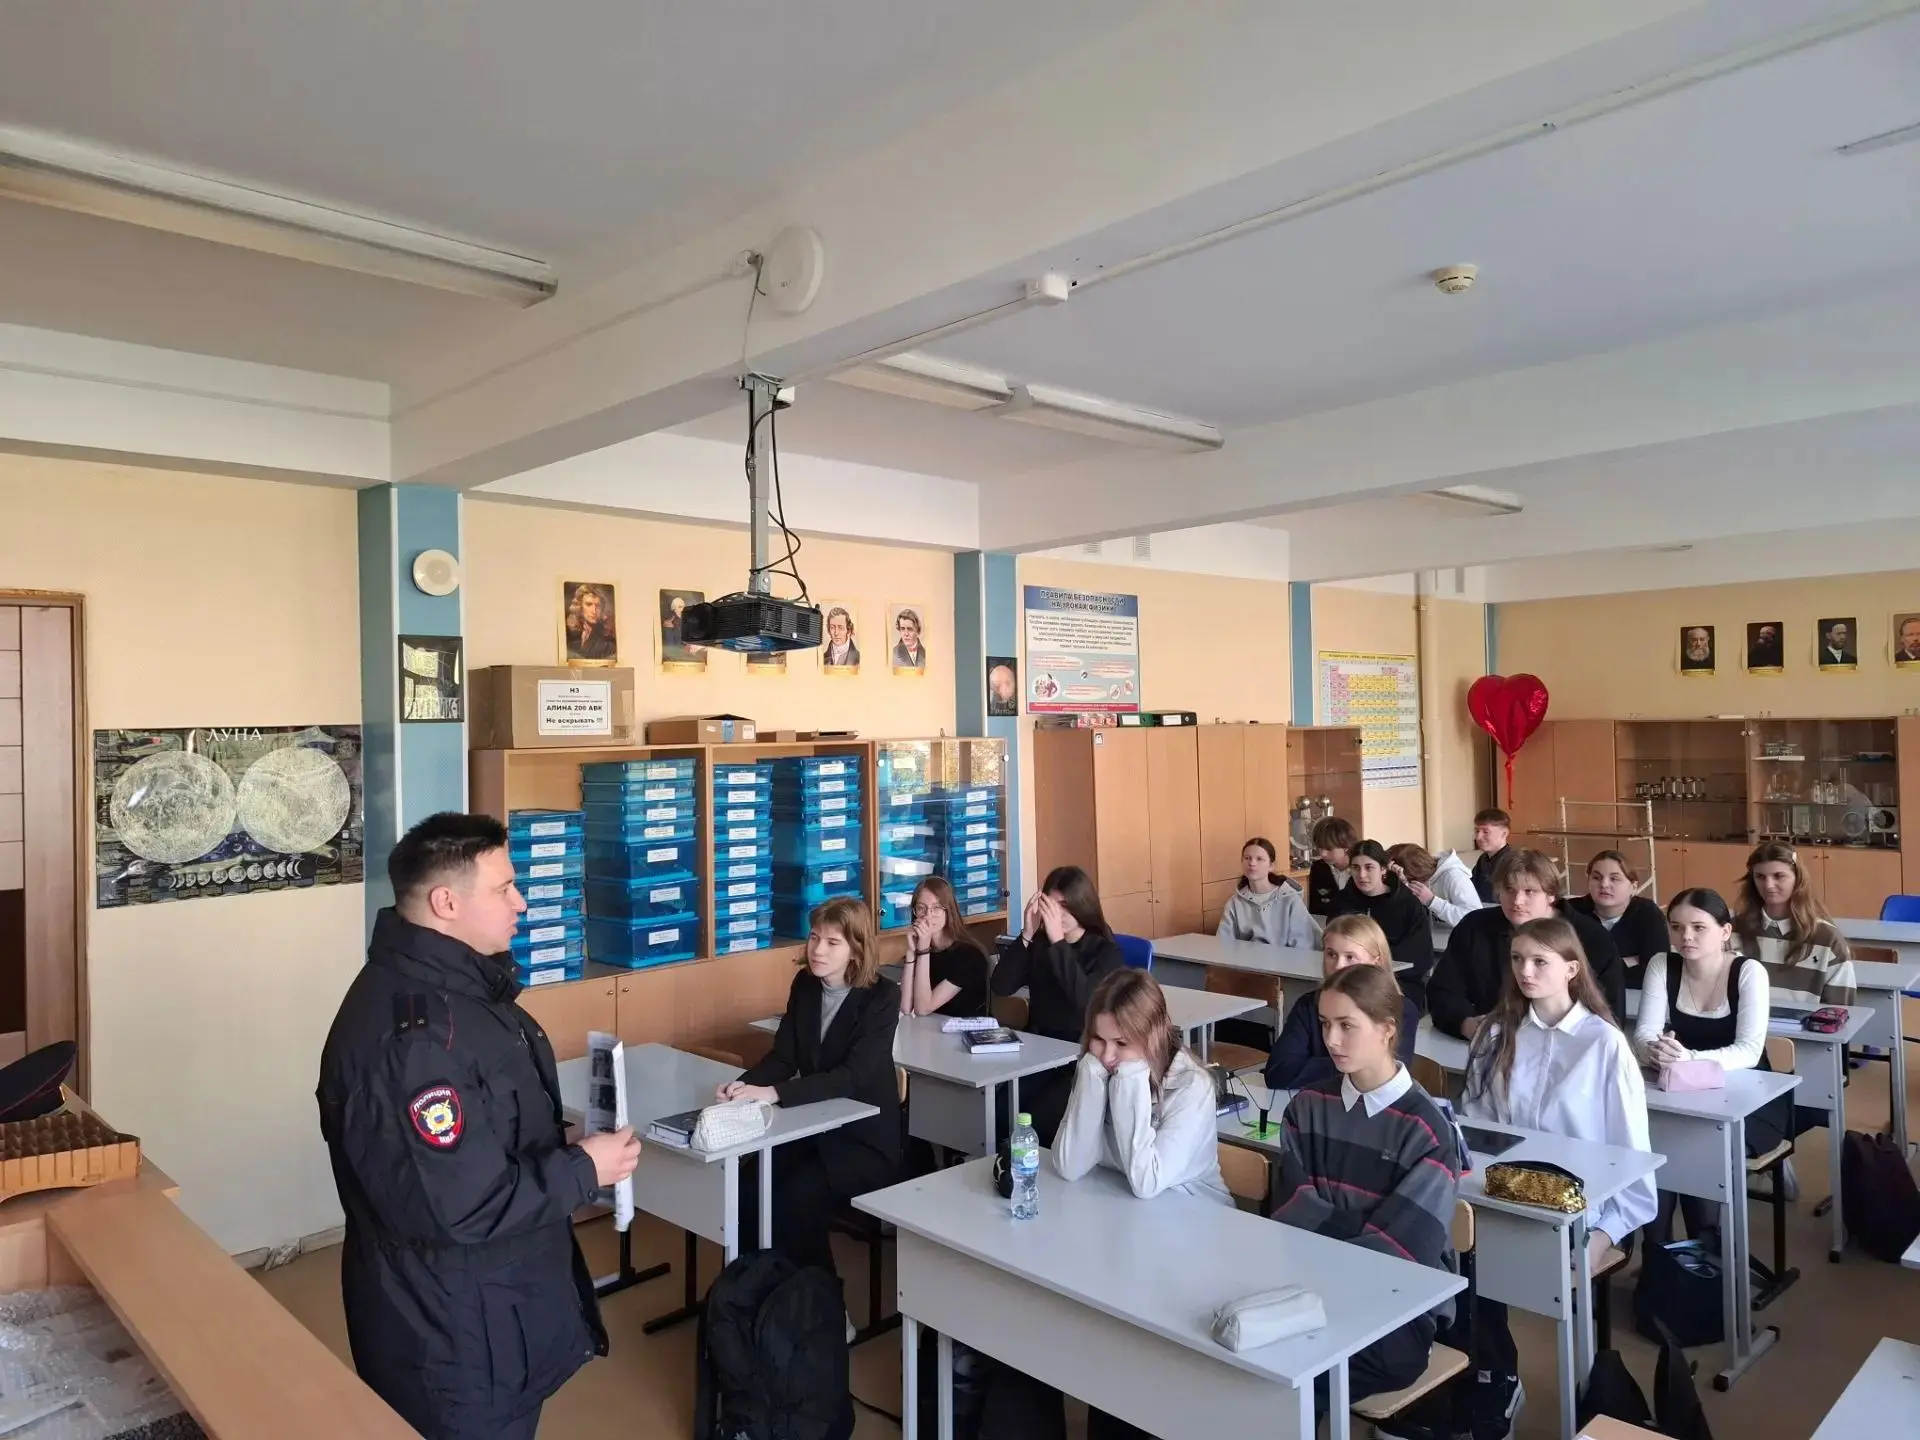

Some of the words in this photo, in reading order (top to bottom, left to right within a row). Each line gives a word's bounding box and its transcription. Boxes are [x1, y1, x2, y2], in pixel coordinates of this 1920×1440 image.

[1040, 590, 1072, 600] ПРАВИЛА
[1073, 592, 1126, 605] БЕЗОПАСНОСТИ
[1062, 602, 1087, 610] УРОКАХ
[1088, 603, 1114, 612] ФИЗИКИ
[206, 728, 262, 741] ЛУНА
[413, 1089, 452, 1113] ПОЛИЦИЯ
[438, 1131, 456, 1144] МВД
